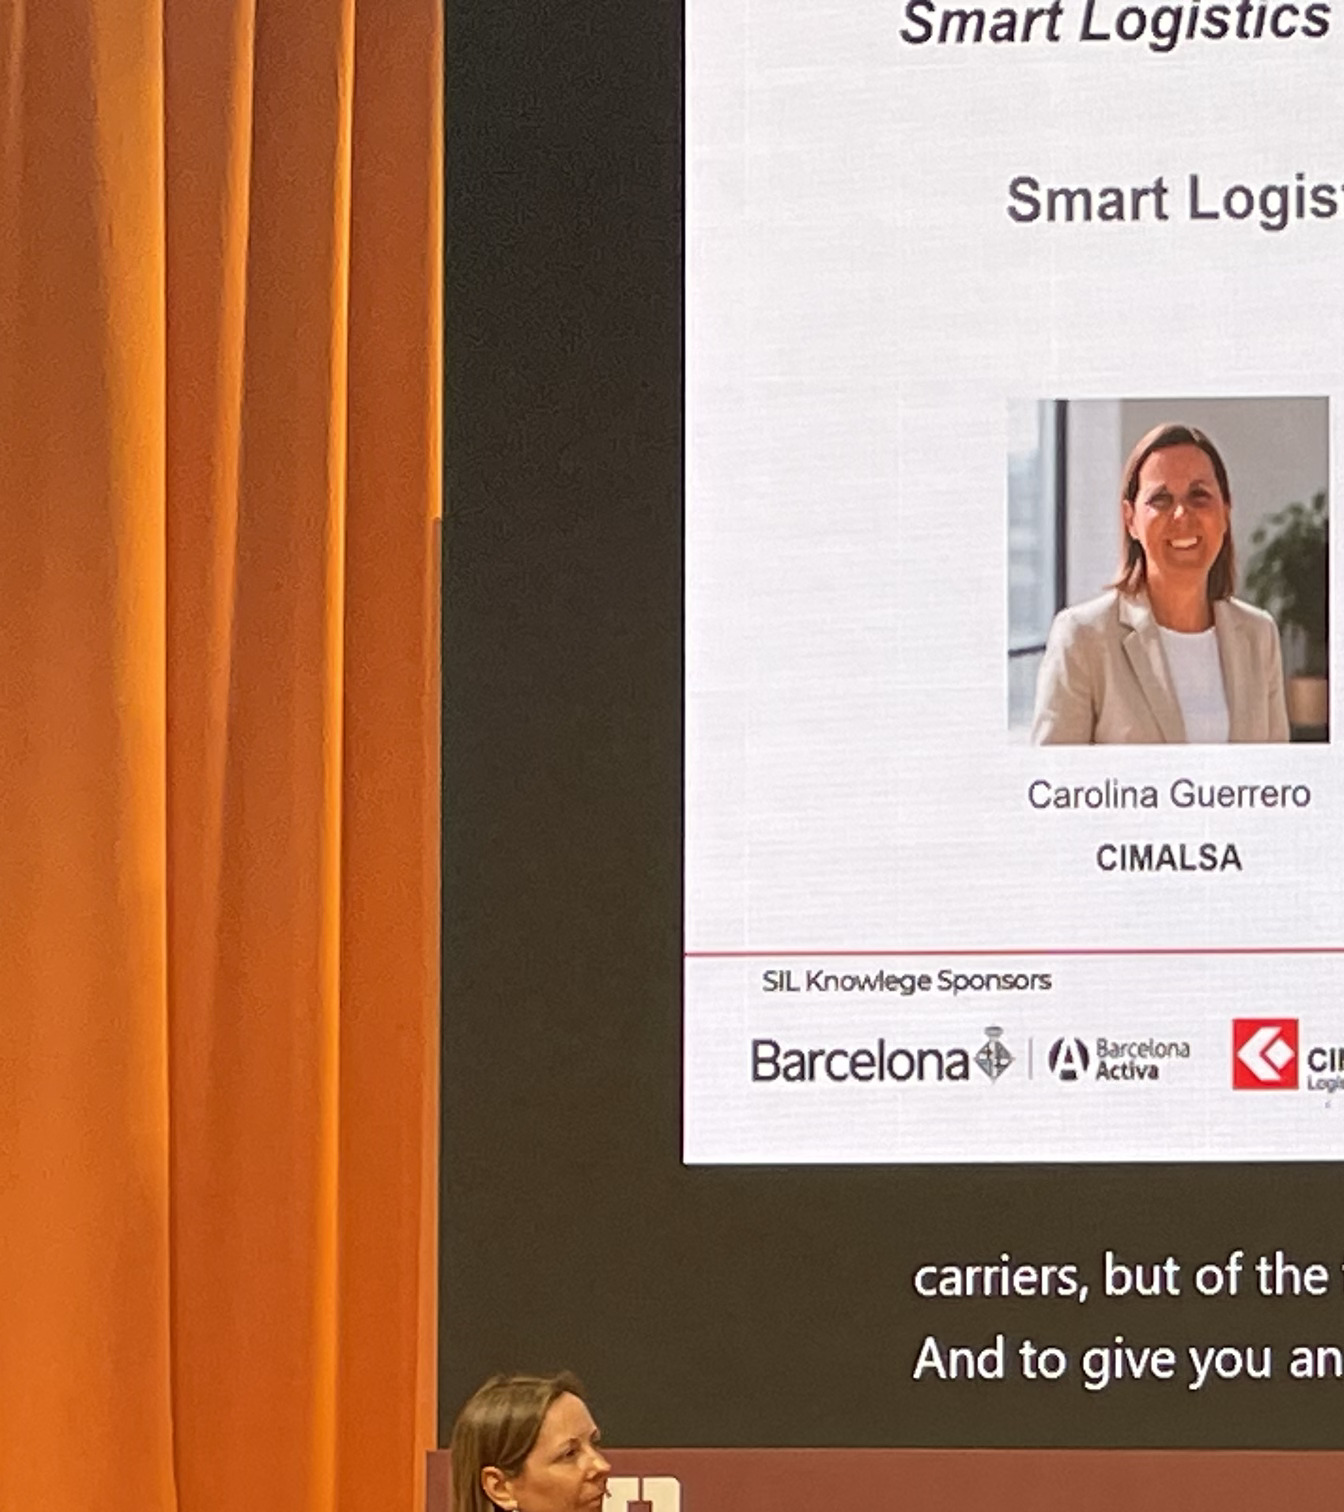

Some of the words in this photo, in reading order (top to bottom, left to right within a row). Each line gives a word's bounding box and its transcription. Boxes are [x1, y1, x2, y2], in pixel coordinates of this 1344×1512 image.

[901, 0, 1063, 44] Smart
[1080, 0, 1330, 52] Logistics
[1008, 177, 1169, 222] Smart
[1029, 780, 1158, 809] Carolina
[1171, 779, 1311, 808] Guerrero
[1097, 843, 1242, 871] CIMALSA
[763, 970, 800, 992] SIL
[807, 970, 932, 996] Knowlege
[938, 970, 1052, 995] Sponsors
[752, 1038, 969, 1082] Barcelona
[1097, 1038, 1190, 1060] Barcelona
[1096, 1061, 1159, 1080] Activa
[915, 1254, 1088, 1302] carriers,
[1106, 1252, 1180, 1295] but
[1196, 1251, 1243, 1294] of
[1256, 1251, 1328, 1294] the
[914, 1335, 1003, 1378] And
[1019, 1341, 1066, 1378] to
[1083, 1336, 1175, 1390] give
[1189, 1348, 1270, 1389] you
[1291, 1348, 1342, 1377] an
